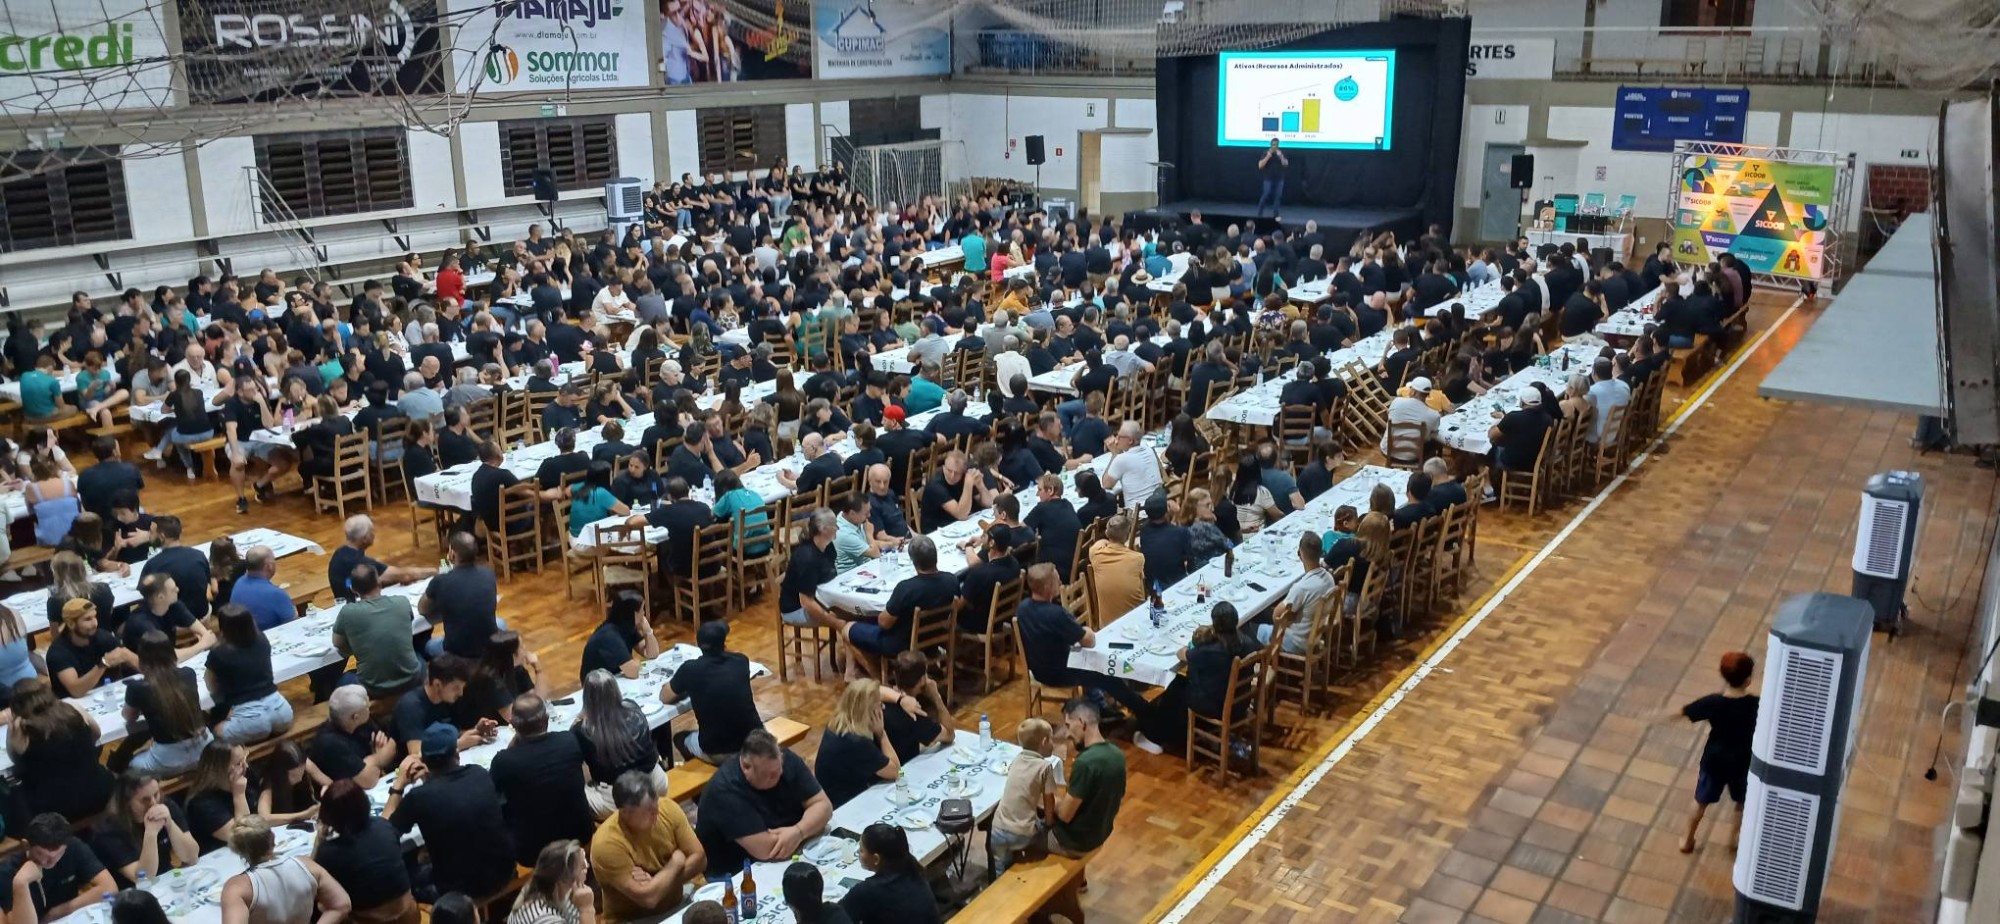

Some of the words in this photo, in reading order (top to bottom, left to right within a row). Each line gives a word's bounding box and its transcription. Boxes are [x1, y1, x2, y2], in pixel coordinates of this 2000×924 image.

[527, 50, 619, 72] sommar
[1289, 62, 1343, 70] Administrados)
[1755, 220, 1785, 230] SICOOB
